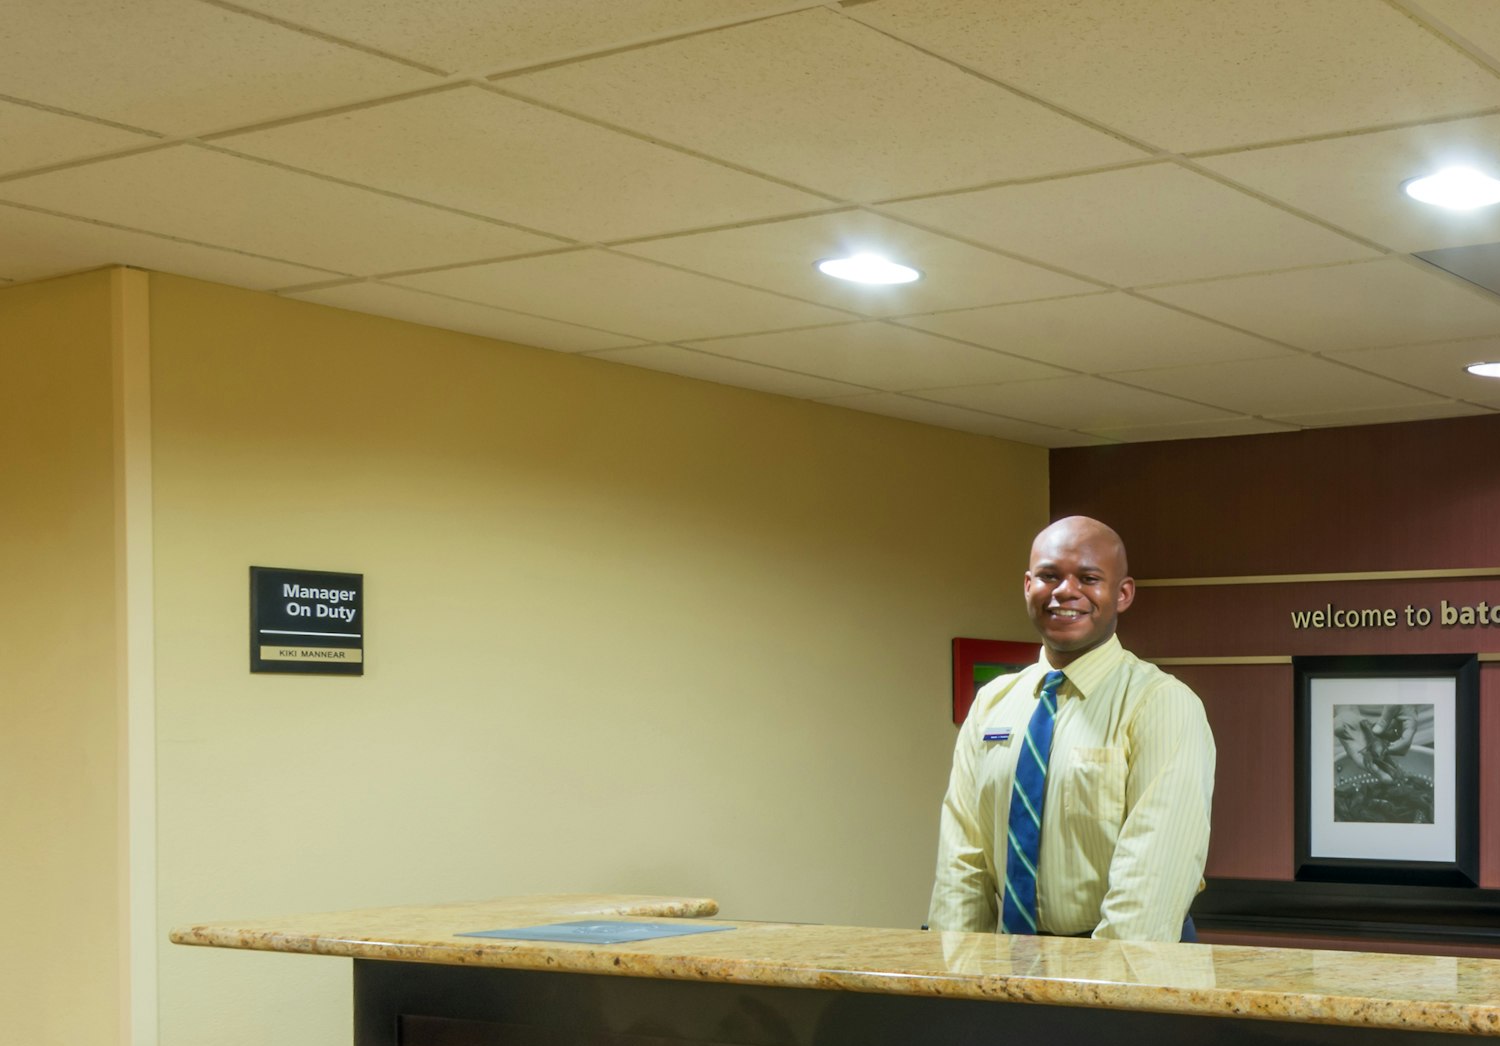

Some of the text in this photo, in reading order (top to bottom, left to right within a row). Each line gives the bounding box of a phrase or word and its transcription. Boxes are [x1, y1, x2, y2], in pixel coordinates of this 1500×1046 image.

[283, 583, 356, 604] Manager
[286, 602, 356, 623] On Duty
[1290, 603, 1397, 629] welcome
[1404, 603, 1432, 627] to
[279, 649, 346, 659] KIKI MANNEAR
